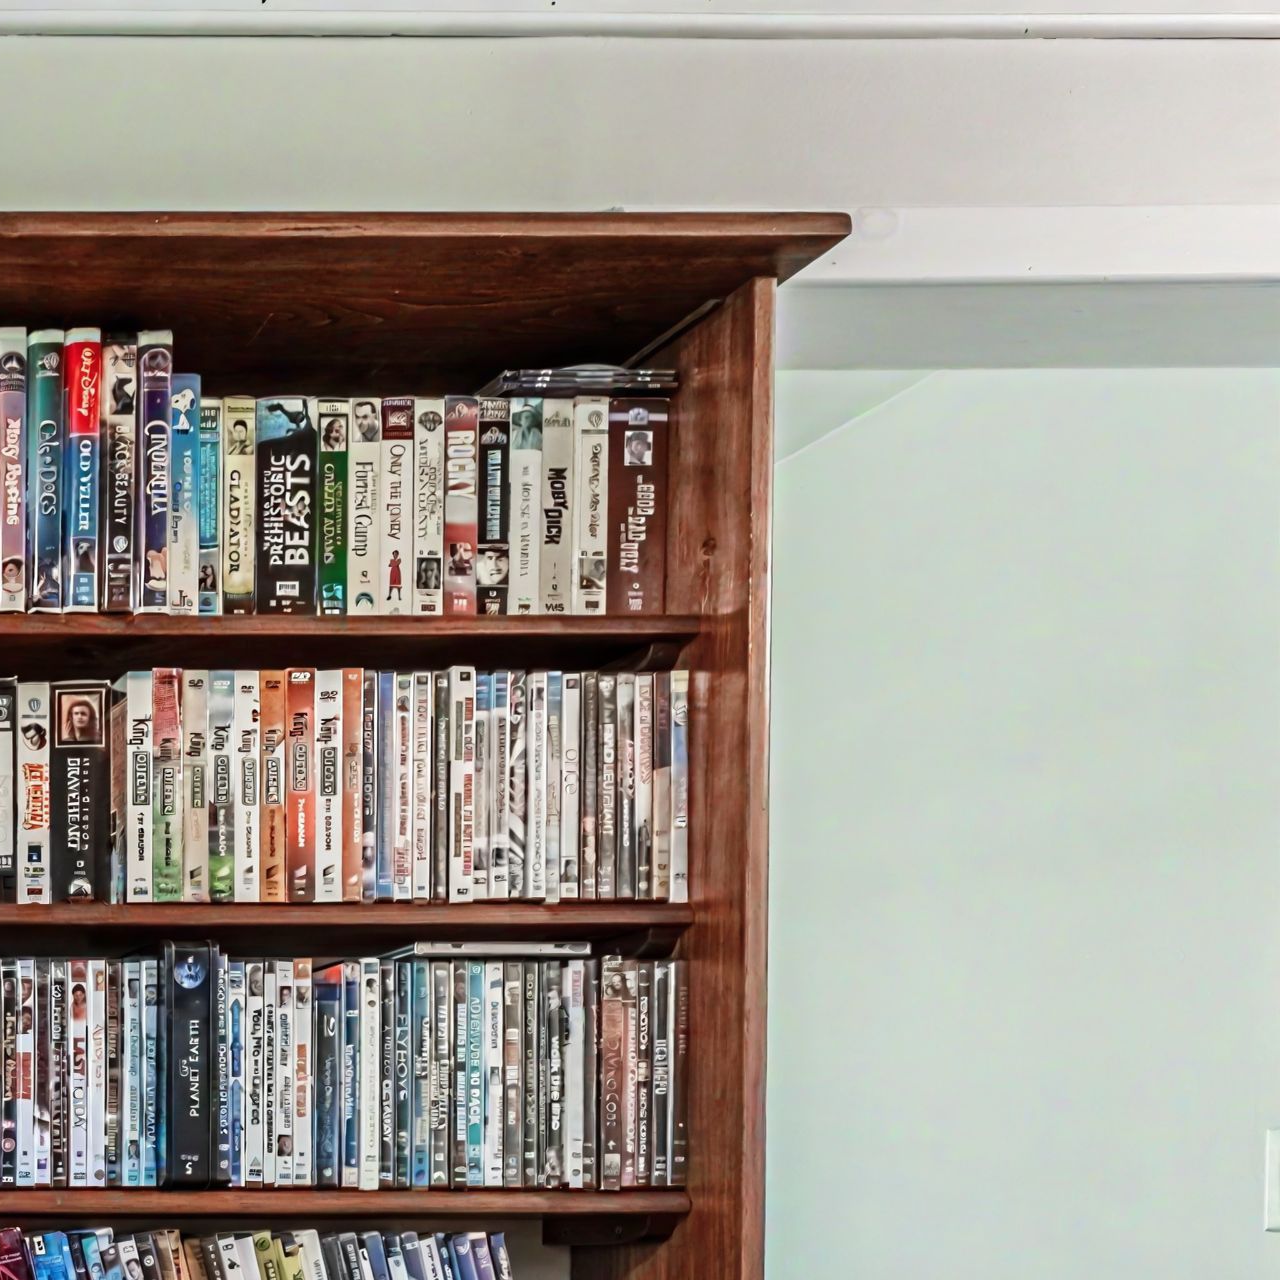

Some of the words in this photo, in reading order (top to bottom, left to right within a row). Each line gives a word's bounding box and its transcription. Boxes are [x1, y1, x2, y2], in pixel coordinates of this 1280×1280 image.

[447, 430, 476, 499] ROCKY
[114, 472, 128, 524] BEAUTY
[270, 455, 285, 565] PREHISTORIC
[285, 454, 311, 565] BEASTS
[548, 468, 568, 510] MOBY
[229, 470, 241, 574] GLADIATOR
[352, 514, 373, 557] Gump
[544, 509, 562, 545] DICK
[189, 1020, 199, 1062] EARTH
[550, 1036, 560, 1072] walk
